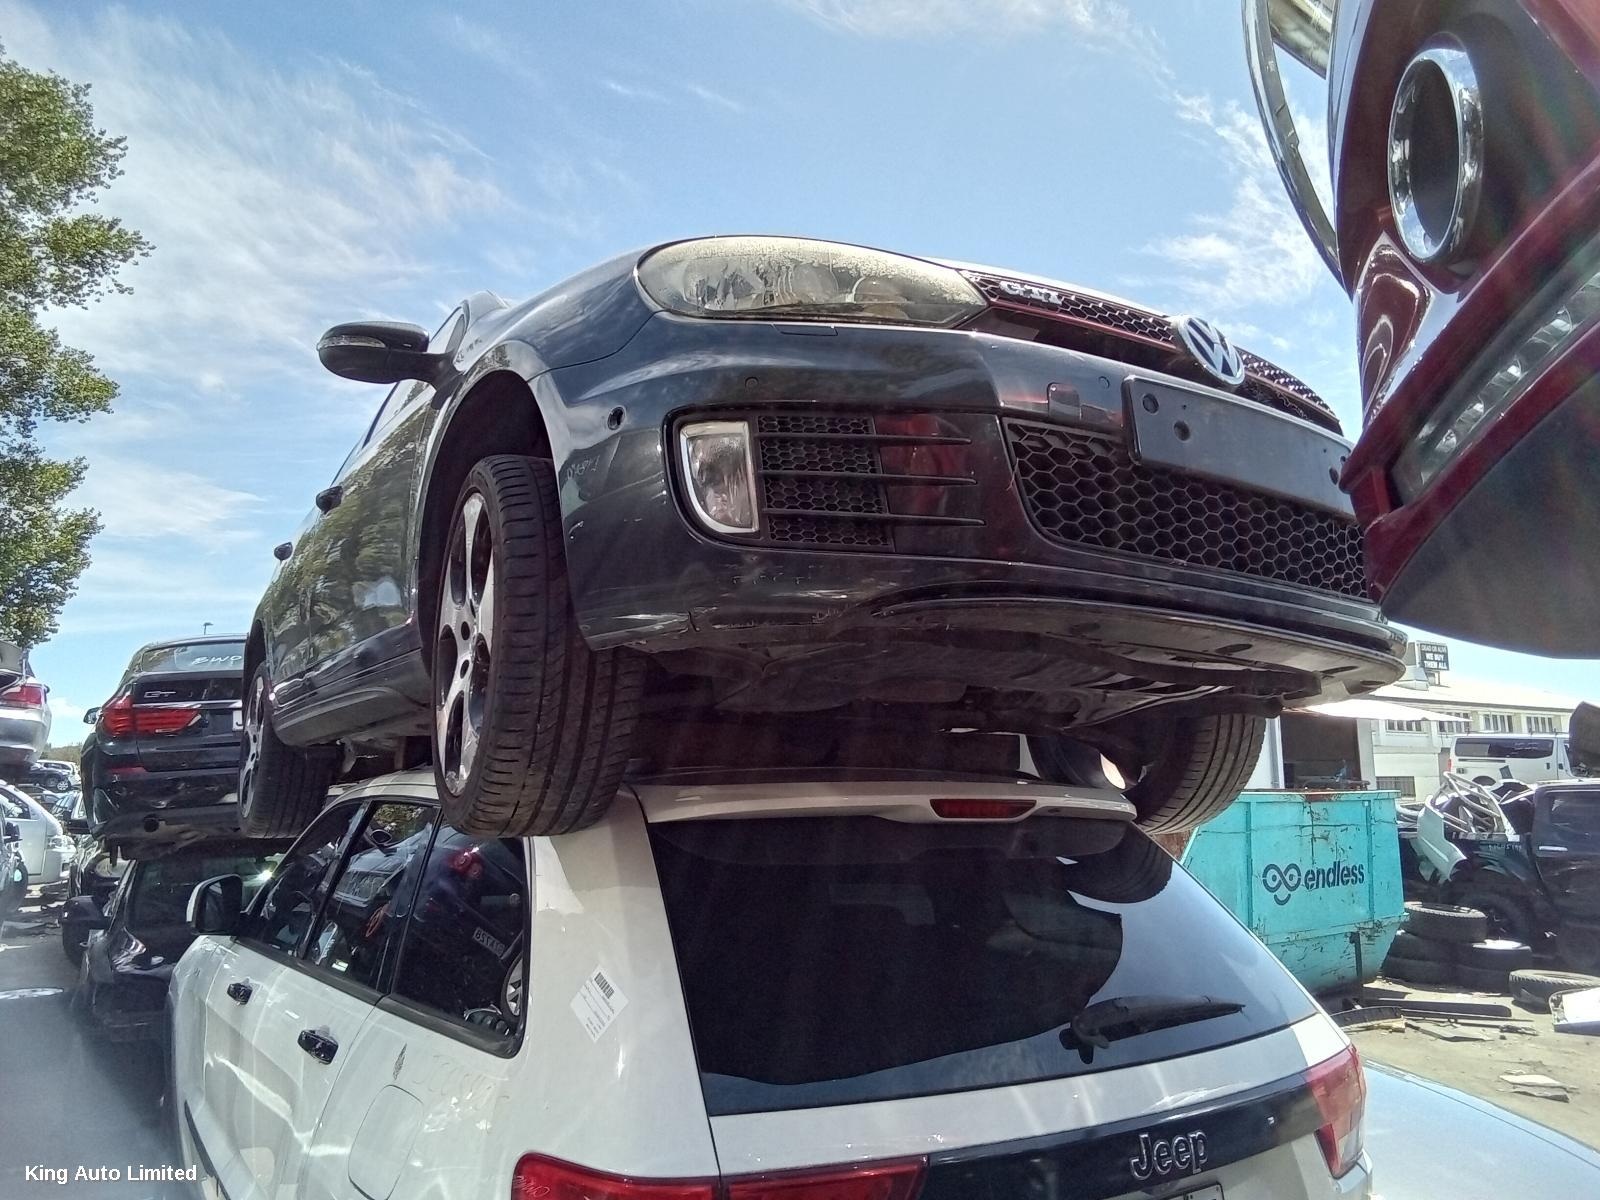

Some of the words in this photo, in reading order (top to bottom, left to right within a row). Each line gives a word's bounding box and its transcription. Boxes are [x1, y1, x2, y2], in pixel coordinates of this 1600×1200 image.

[1000, 281, 1062, 304] GTI
[1425, 652, 1434, 660] WE
[1434, 653, 1444, 661] BUY
[1438, 661, 1448, 669] ALL
[1304, 860, 1365, 890] endless
[1130, 1131, 1208, 1180] Jeep
